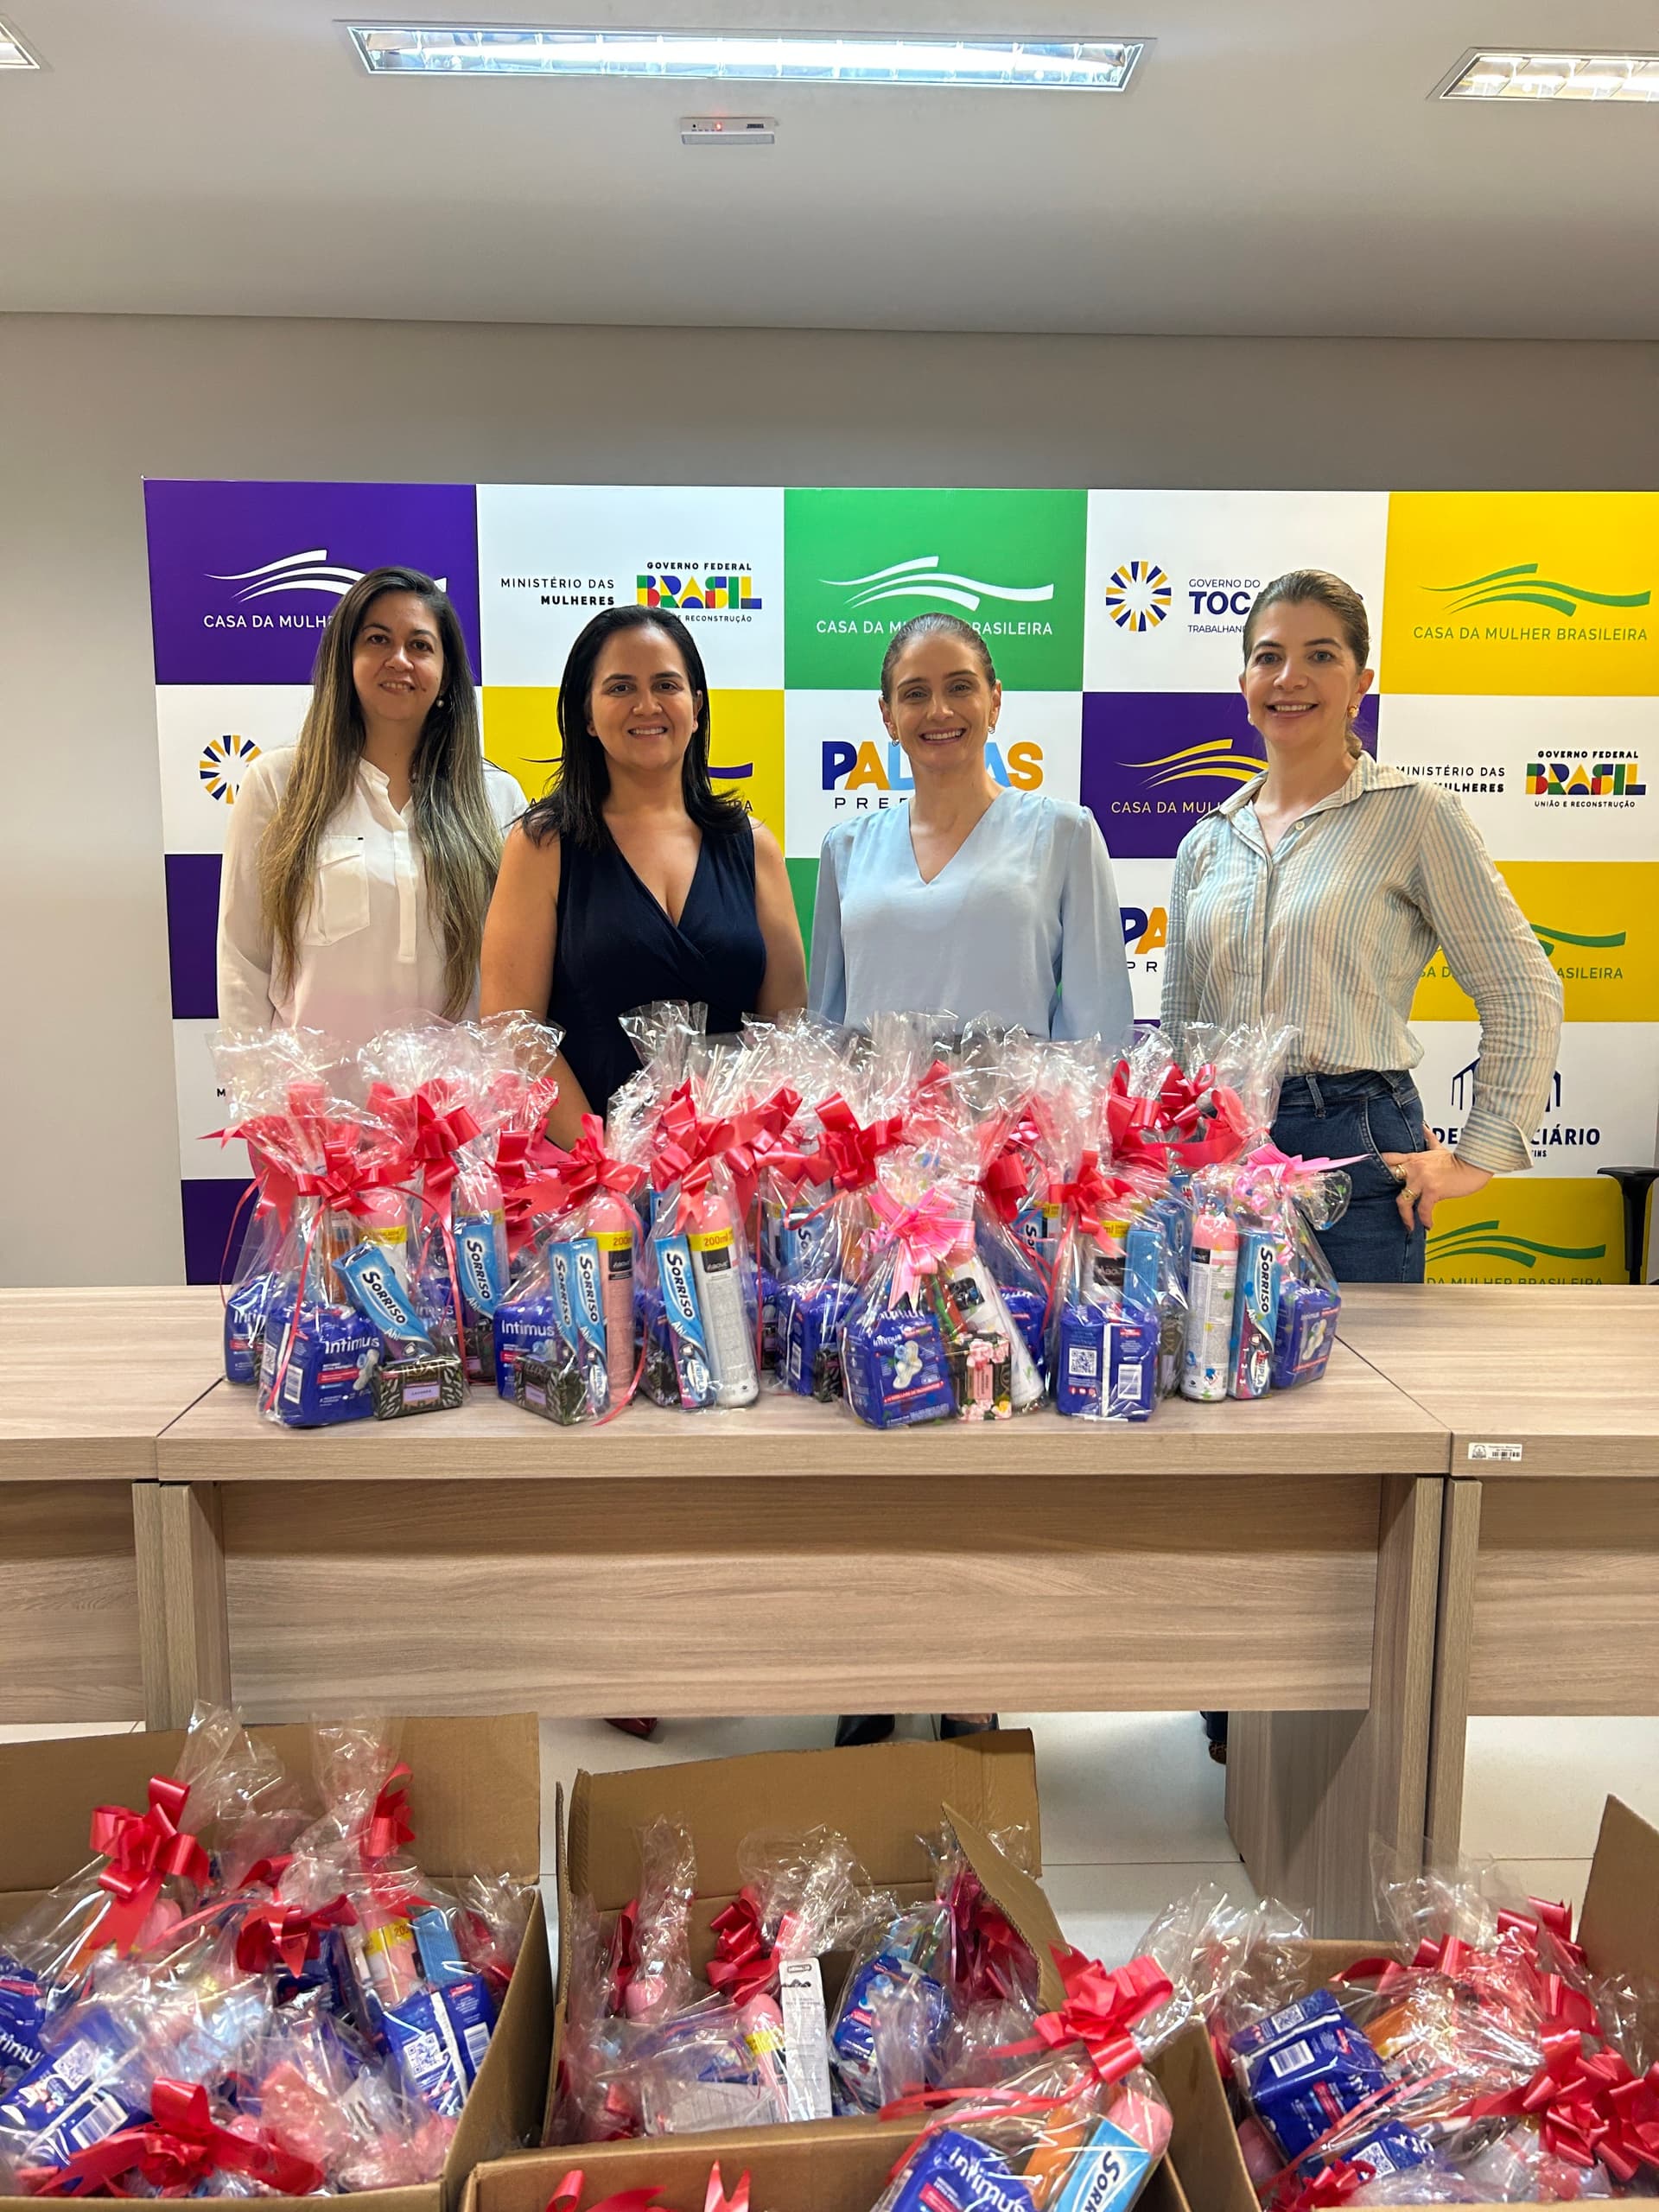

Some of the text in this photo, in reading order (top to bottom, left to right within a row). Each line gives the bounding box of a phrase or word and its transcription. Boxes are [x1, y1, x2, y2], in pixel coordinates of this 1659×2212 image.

[646, 562, 753, 571] GOVERNO FEDERAL
[500, 575, 615, 589] MINISTÉRIO DAS
[1188, 578, 1261, 588] GOVERNO DO
[540, 594, 615, 606] MULHERES
[636, 575, 762, 610] BRASIL
[1188, 591, 1251, 615] TOC
[203, 614, 334, 628] CASA DA MULH
[684, 614, 753, 623] RECONSTRUÇÃO
[816, 620, 858, 633] CASA
[863, 621, 885, 633] DA
[971, 621, 1053, 635] RASILEIRA
[1187, 625, 1246, 633] TRABALHAN
[1413, 626, 1648, 641] CASA DA MULHER BRASILEIRA
[1537, 750, 1588, 759] GOVERNO
[822, 741, 1044, 791] PALAS
[1480, 767, 1505, 777] DAS
[1434, 782, 1504, 792] ULHERES
[1525, 763, 1647, 796] BRASIL
[1111, 802, 1152, 813] CASA
[1156, 802, 1177, 813] DA
[1534, 799, 1560, 808] UNIÃO
[1570, 800, 1636, 809] RECONSTRUÇÃO
[1557, 967, 1624, 979] ASILEIRA
[467, 1240, 492, 1300] SORRISO
[666, 1252, 694, 1318] SORRISO
[1261, 1247, 1273, 1313] SORRISO
[580, 1255, 599, 1324] SORRISO
[363, 1271, 406, 1324] SORRISO
[501, 1319, 555, 1337] Intimus
[325, 1336, 380, 1354] Intimus
[1084, 2150, 1121, 2212] SORR
